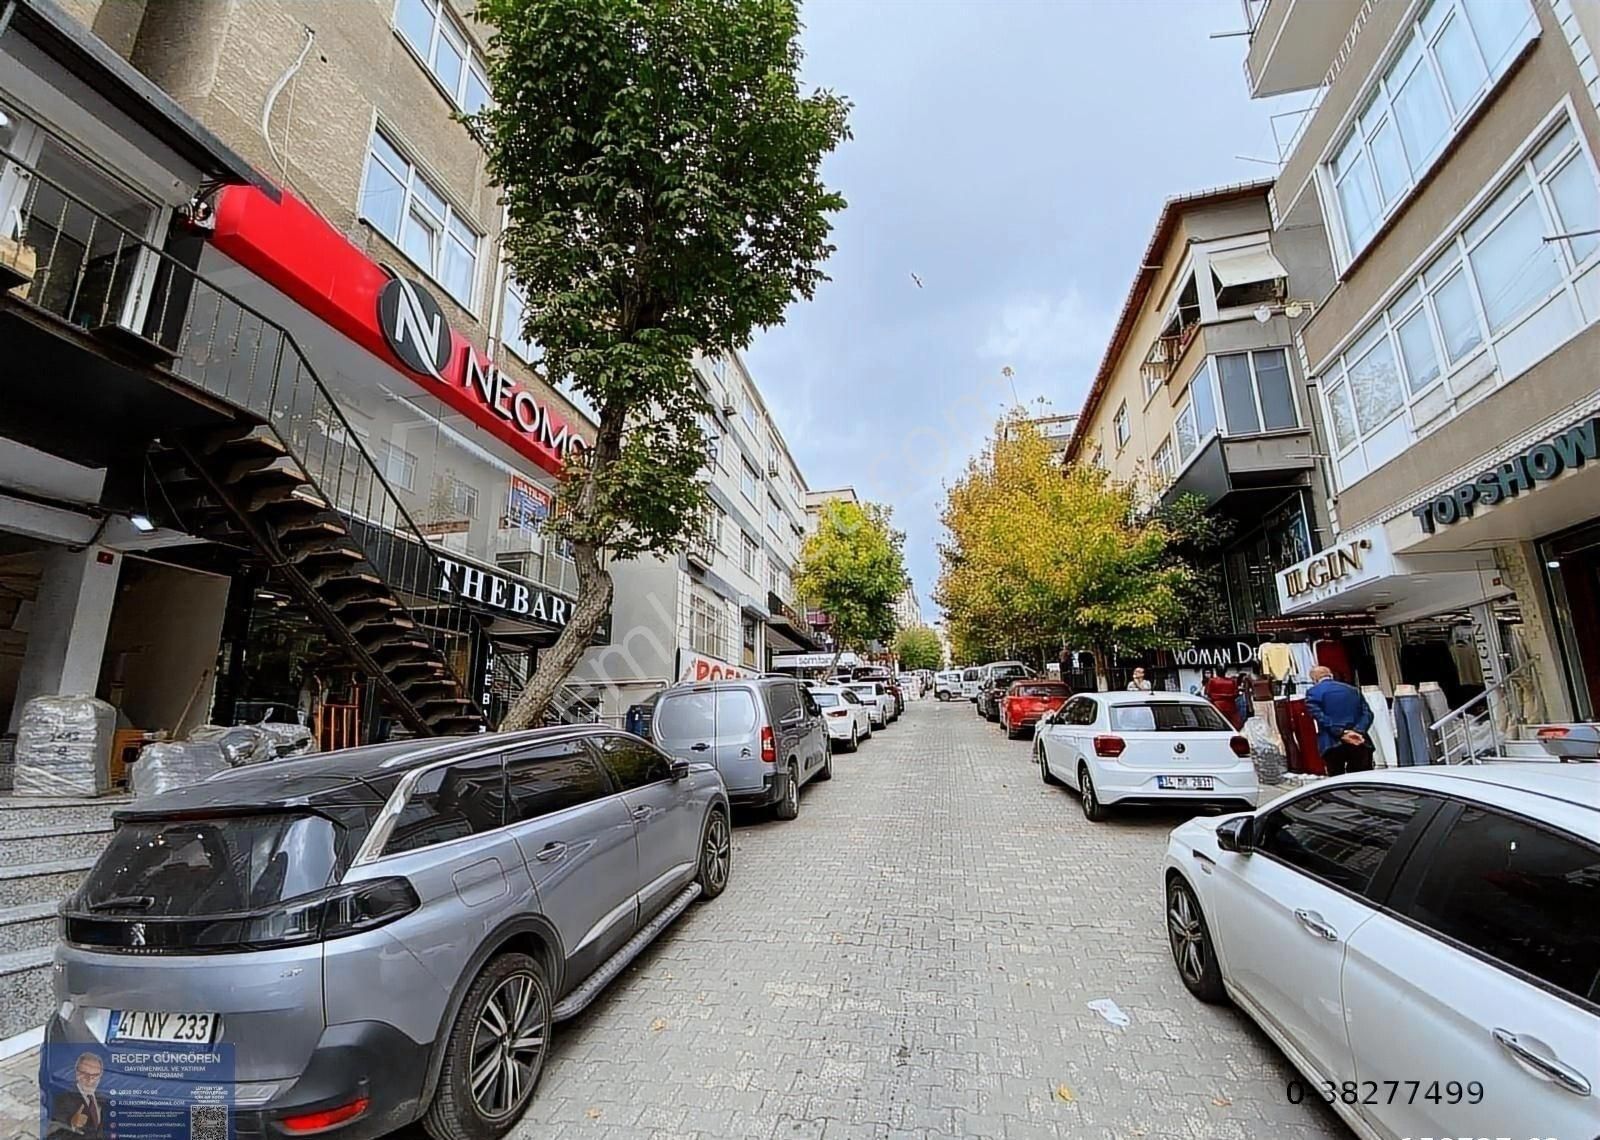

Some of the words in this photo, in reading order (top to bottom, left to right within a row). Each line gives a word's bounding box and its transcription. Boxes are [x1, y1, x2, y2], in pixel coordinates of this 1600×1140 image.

[1412, 416, 1600, 534] TOPSHOW
[1283, 540, 1364, 599] ILGIN
[1172, 647, 1232, 665] WOMAN
[117, 1010, 137, 1036] 41
[141, 1011, 170, 1039] NY
[173, 1013, 209, 1041] 233
